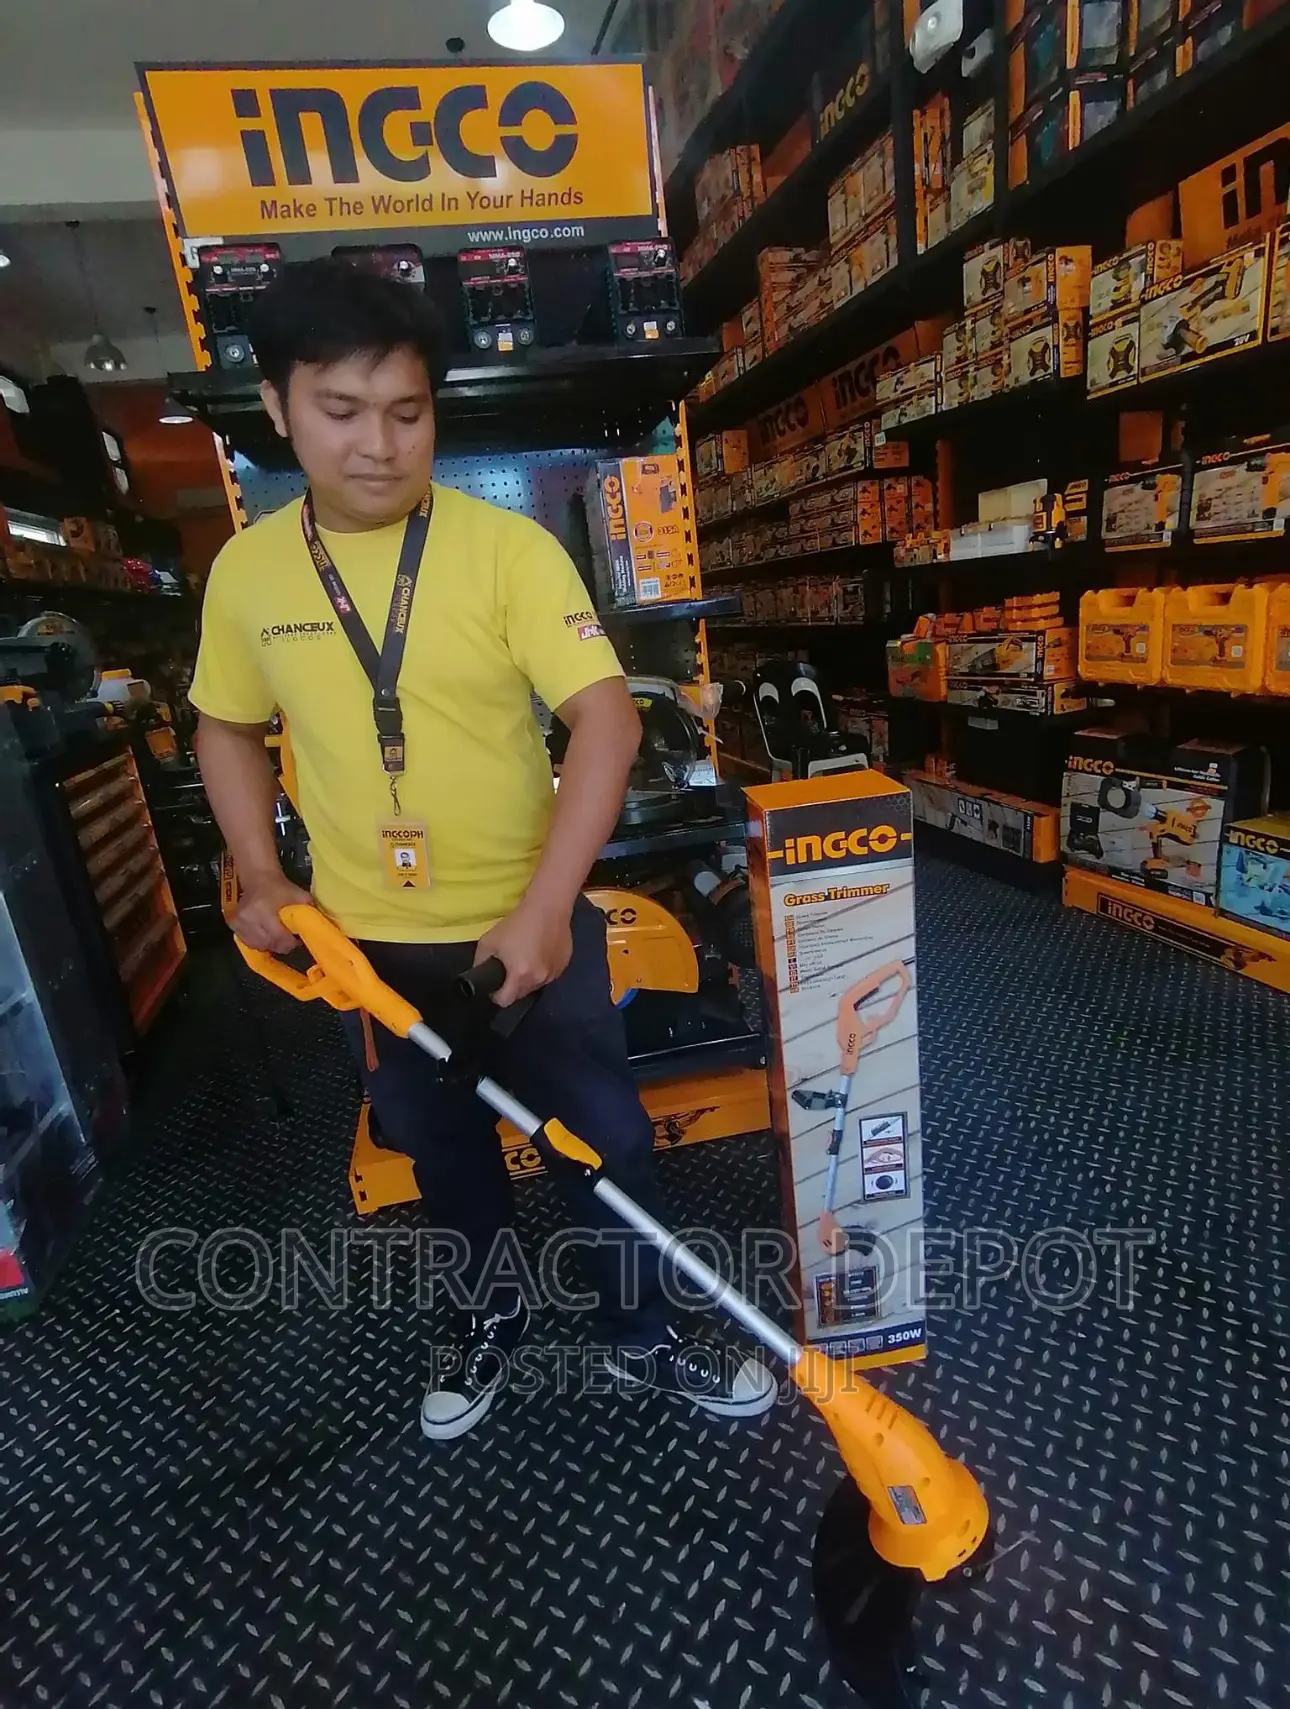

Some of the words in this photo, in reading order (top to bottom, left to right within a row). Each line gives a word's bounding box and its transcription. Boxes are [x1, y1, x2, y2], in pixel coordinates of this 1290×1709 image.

[260, 199, 317, 219] Make
[324, 197, 364, 216] The
[371, 193, 433, 214] World
[441, 192, 459, 211] In
[466, 190, 513, 210] Your
[520, 187, 584, 208] Hands
[272, 621, 334, 635] CHANCEUX
[784, 890, 826, 908] Grass
[827, 883, 890, 901] Trimmer
[887, 1328, 922, 1344] 350W
